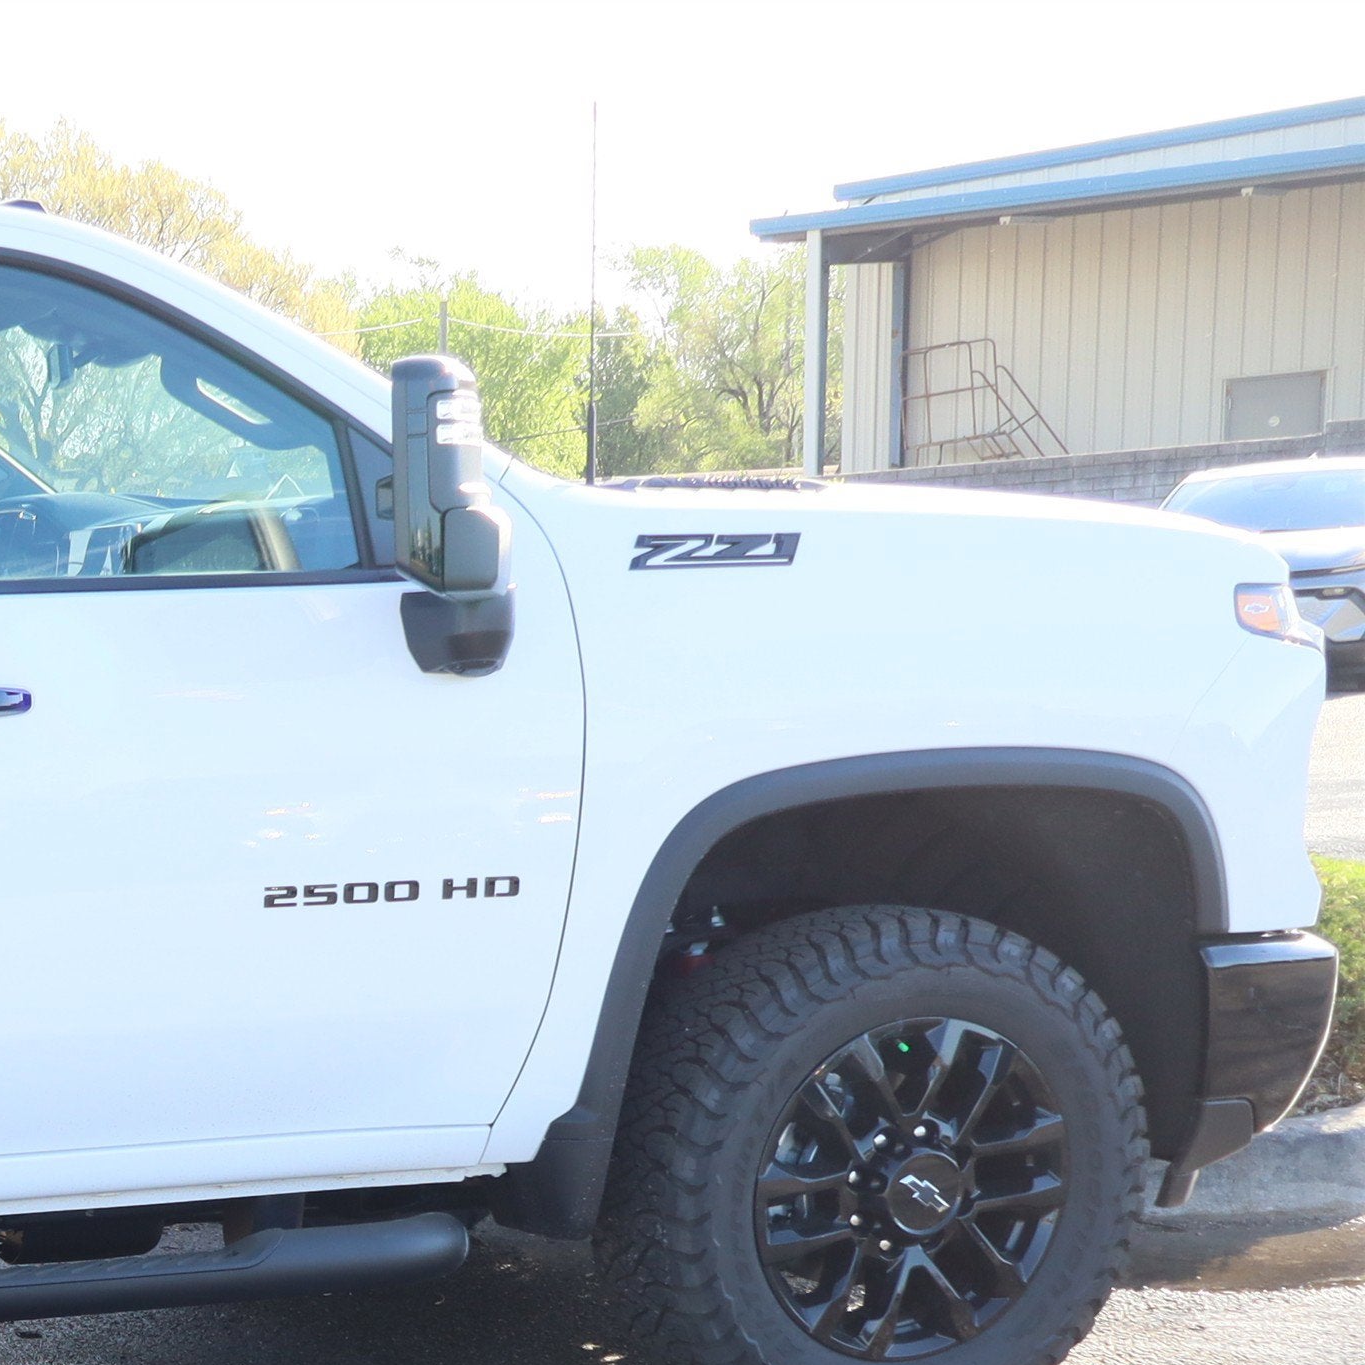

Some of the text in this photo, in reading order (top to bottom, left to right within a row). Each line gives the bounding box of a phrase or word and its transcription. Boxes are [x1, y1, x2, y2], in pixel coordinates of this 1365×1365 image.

[629, 533, 802, 571] Z71
[264, 876, 520, 908] 2500 HD
